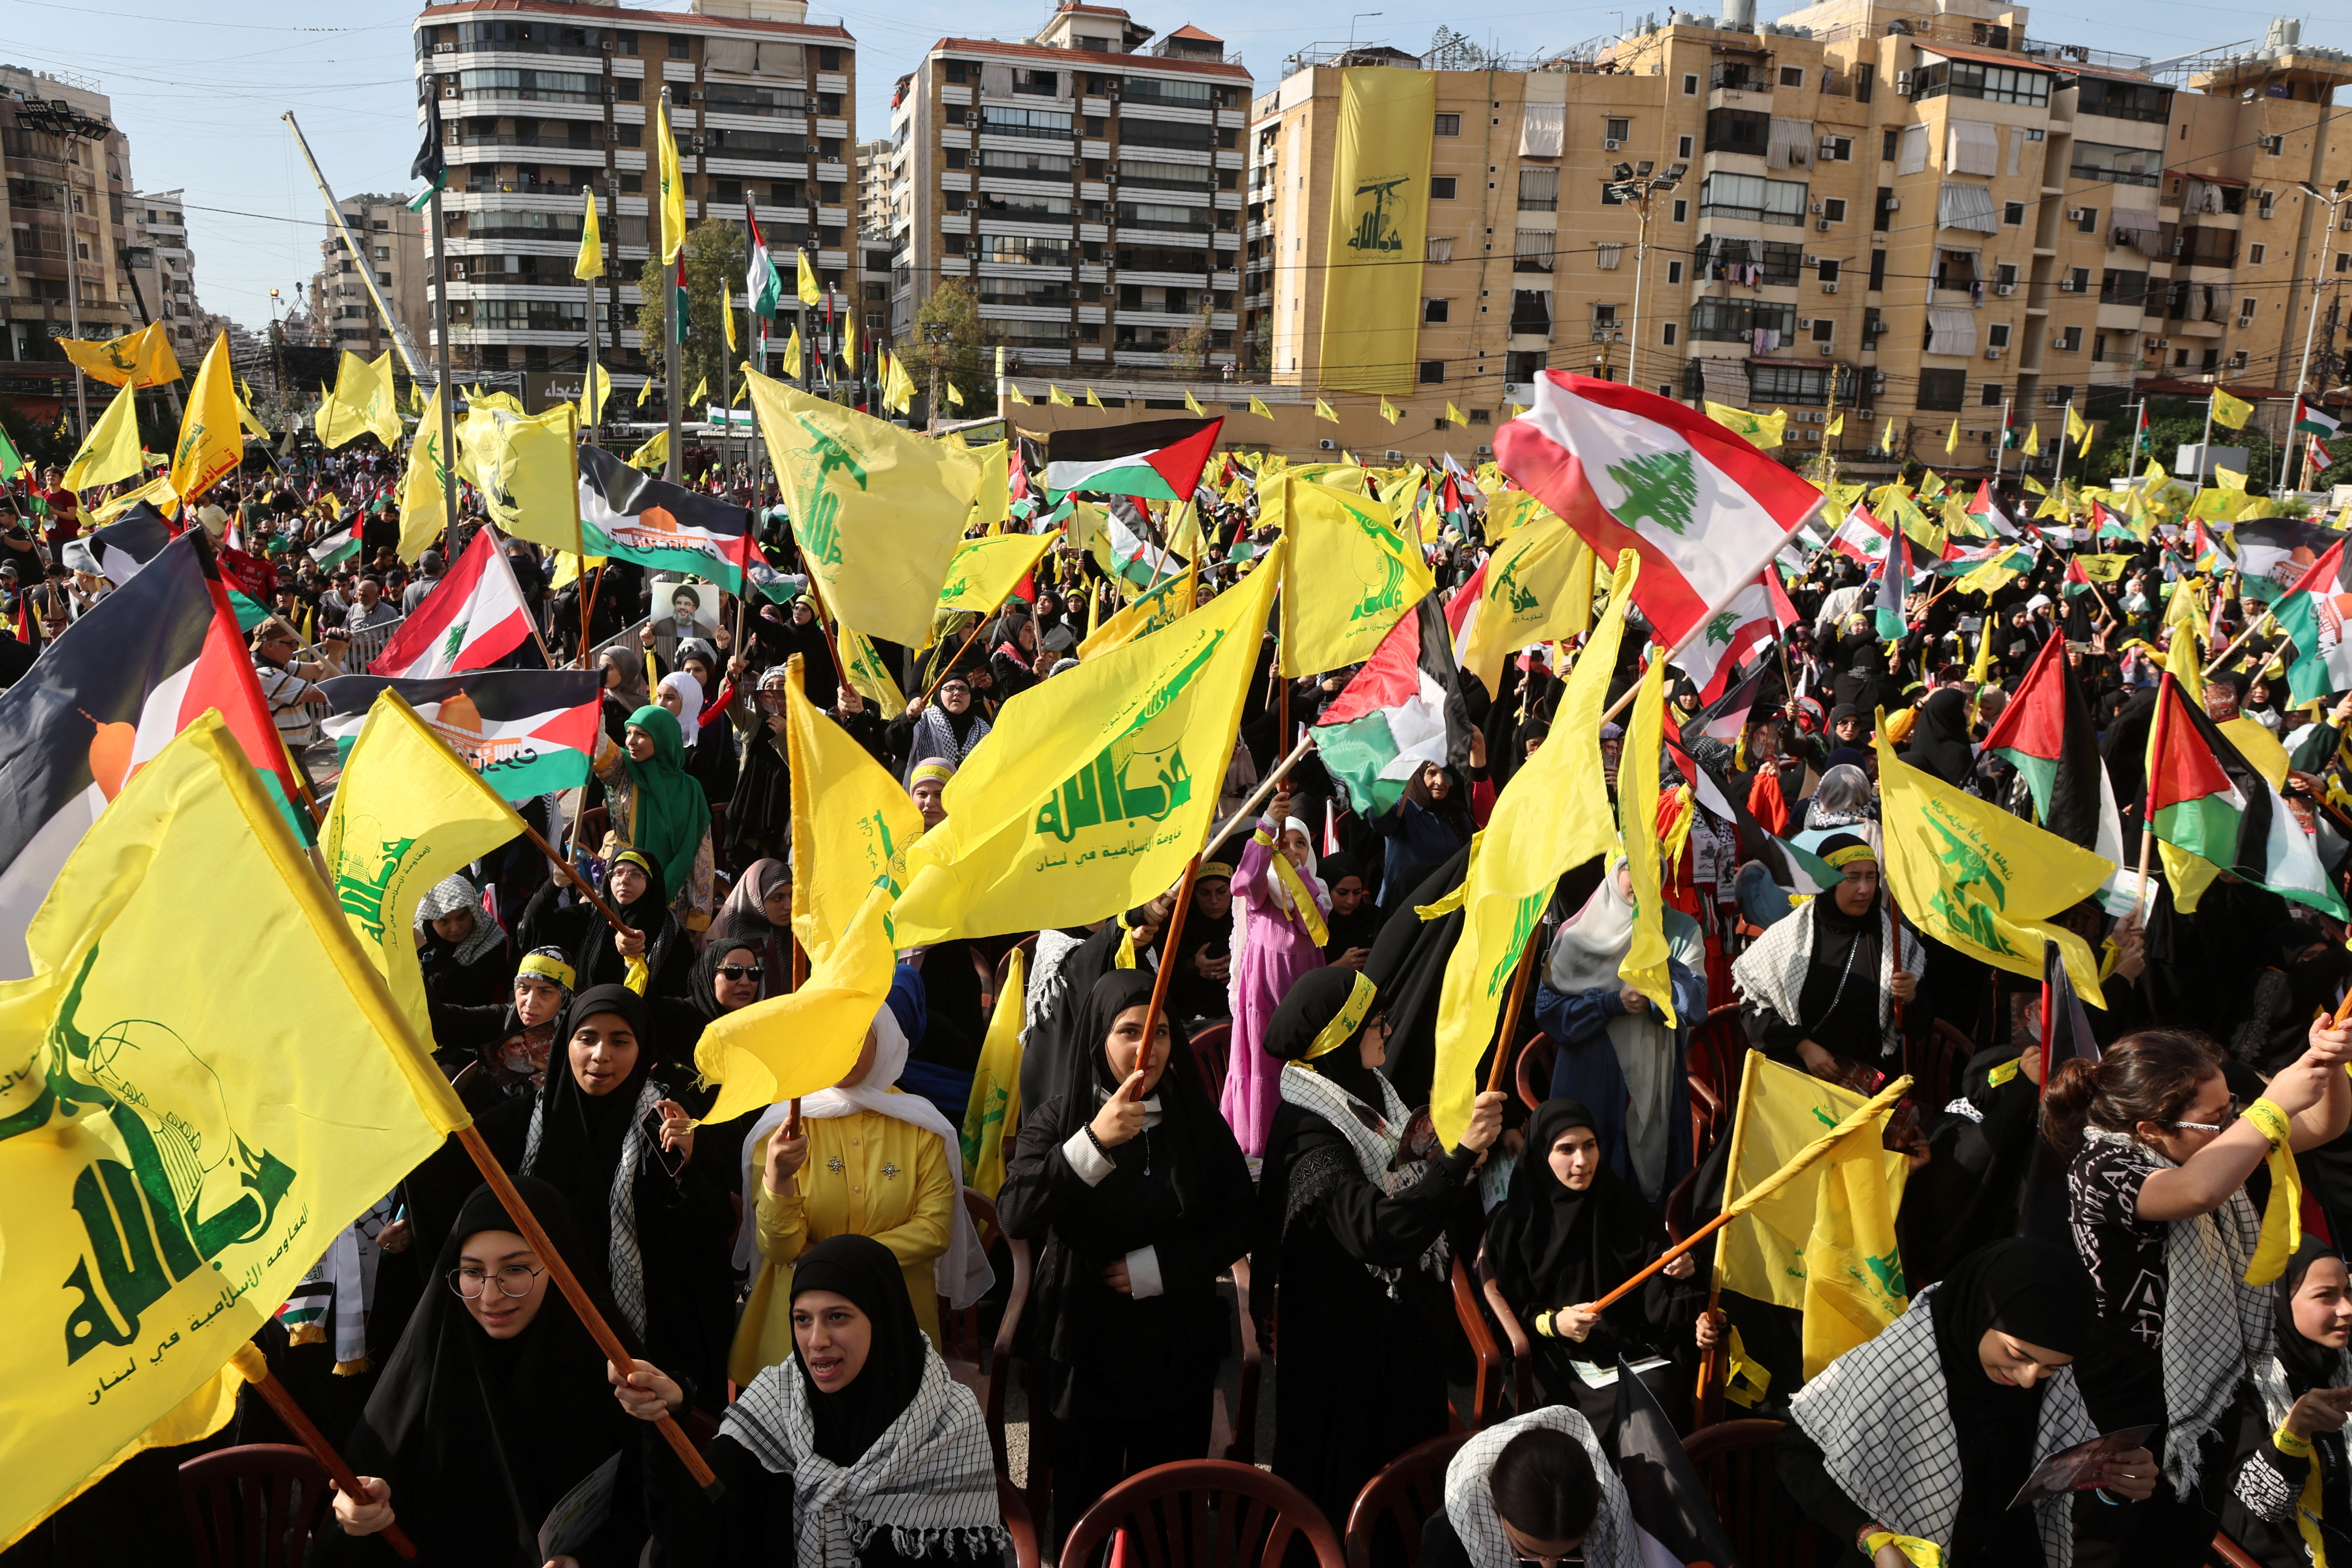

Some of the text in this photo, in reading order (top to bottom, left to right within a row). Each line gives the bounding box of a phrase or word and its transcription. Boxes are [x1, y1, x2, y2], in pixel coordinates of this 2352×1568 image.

[1036, 852, 1067, 872] لبنان
[1075, 847, 1096, 867] في
[265, 1201, 309, 1269] المقاومة
[149, 1327, 181, 1365] في
[88, 1356, 136, 1405] لبنان
